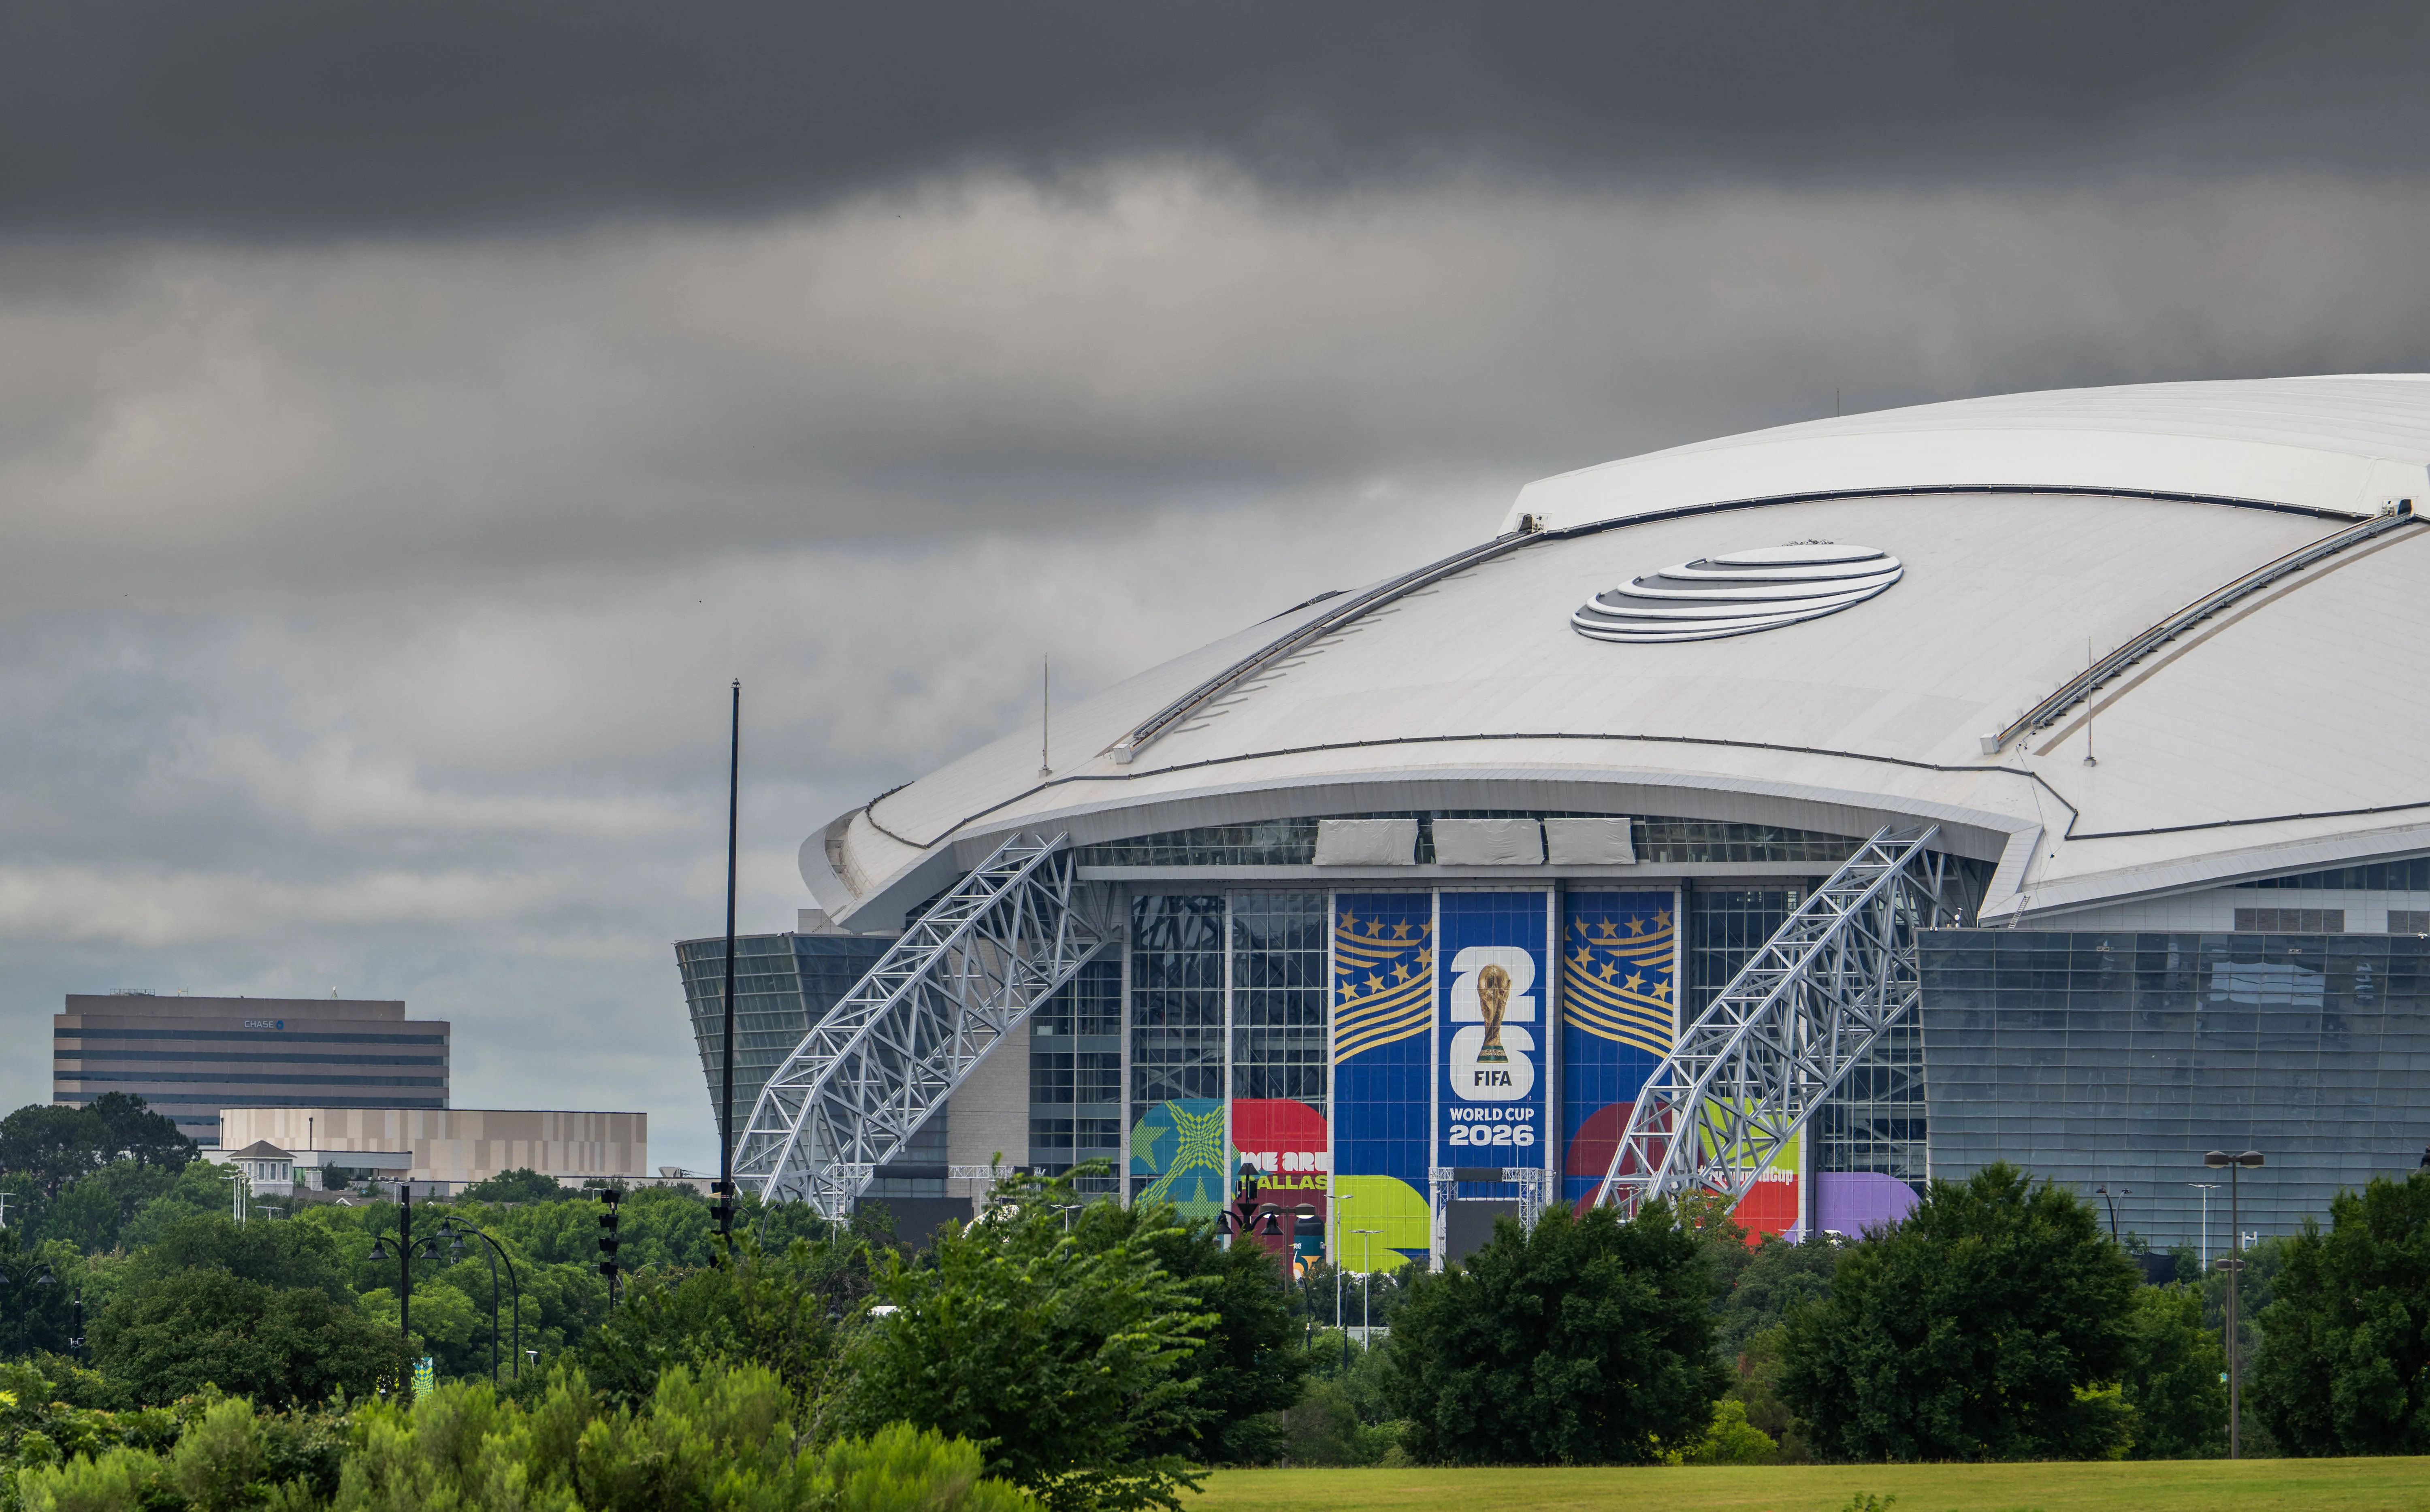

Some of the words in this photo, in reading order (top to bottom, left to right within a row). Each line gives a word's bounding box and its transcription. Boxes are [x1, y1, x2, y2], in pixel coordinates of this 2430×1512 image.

[1475, 1071, 1512, 1086] FIFA
[1449, 1108, 1503, 1121] WORLD
[1505, 1107, 1535, 1121] CUP
[1449, 1124, 1534, 1146] 2026
[1241, 1152, 1278, 1171] WE
